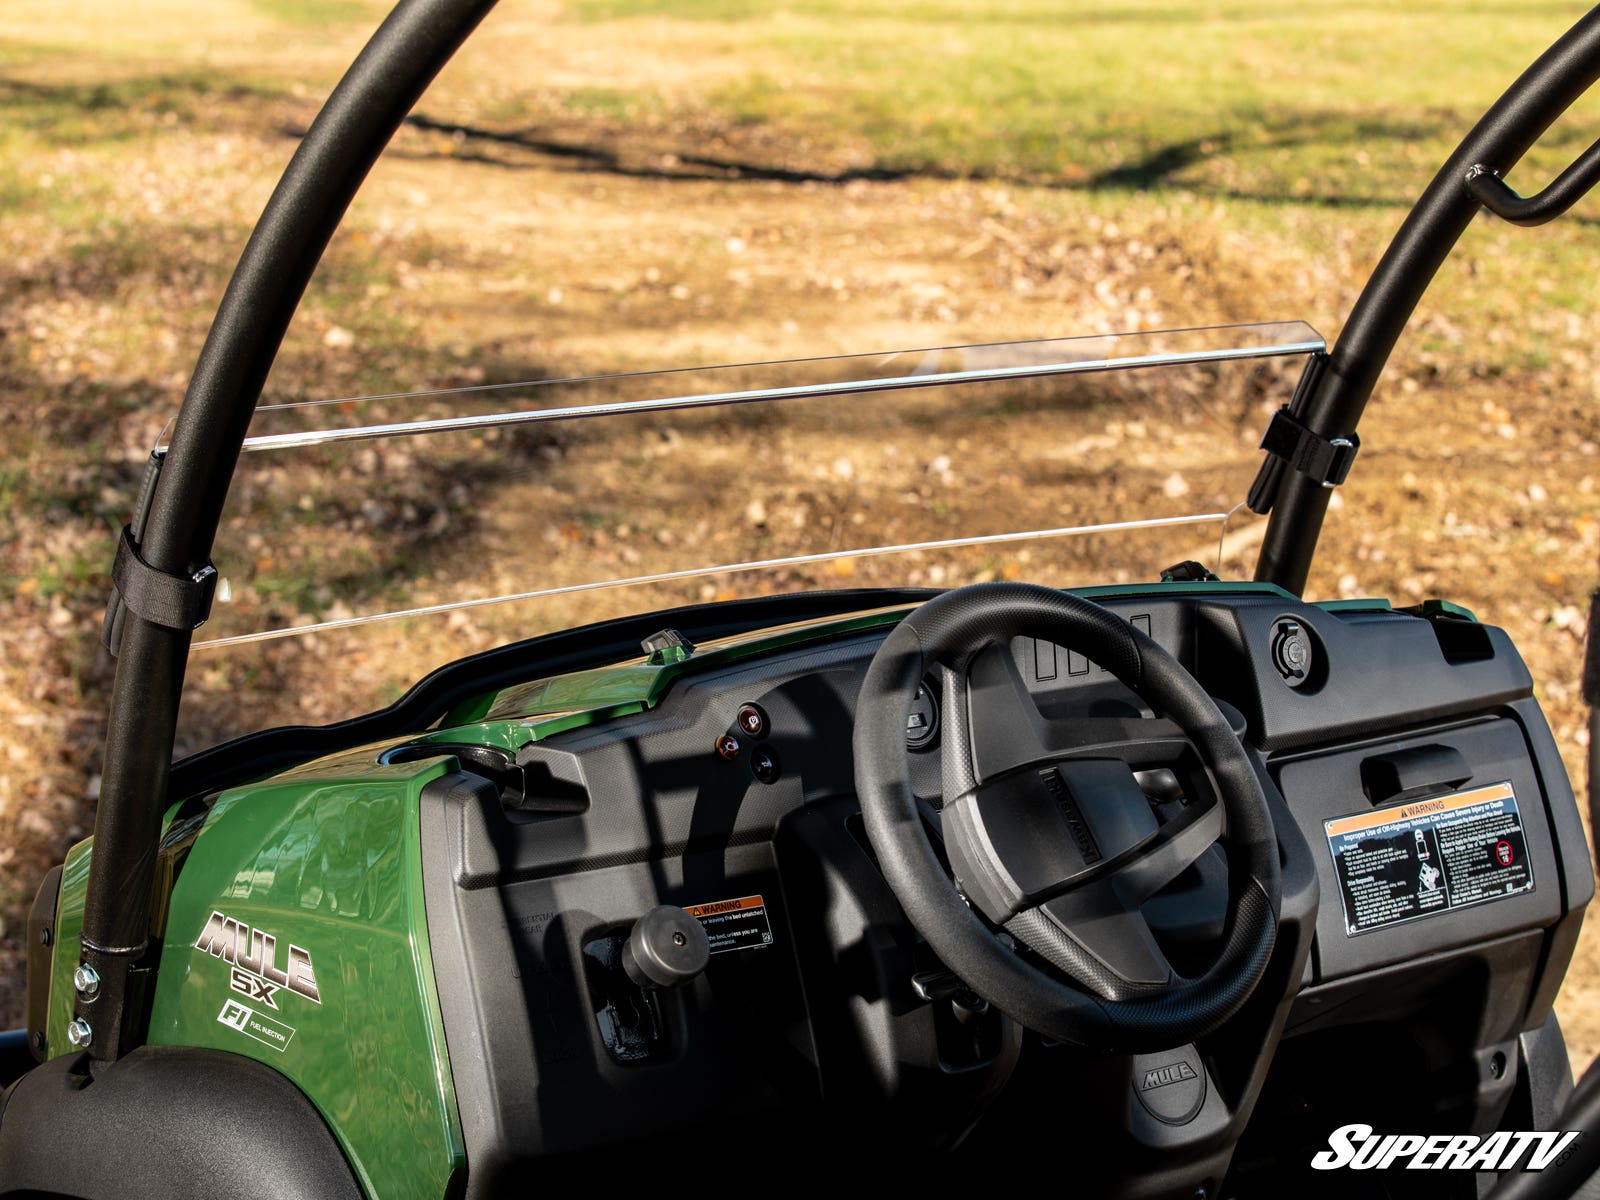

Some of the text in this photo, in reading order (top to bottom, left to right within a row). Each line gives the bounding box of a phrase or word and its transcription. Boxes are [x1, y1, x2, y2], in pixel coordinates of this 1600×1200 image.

[1407, 800, 1444, 816] WARNING
[1343, 830, 1366, 842] Improper
[1365, 828, 1376, 836] Use
[1381, 820, 1410, 834] Off-Highway
[1410, 816, 1429, 826] Vehicles
[1440, 811, 1455, 819] Cause
[1454, 807, 1471, 816] Severe
[1470, 804, 1484, 814] Injury
[1489, 800, 1504, 808] Death
[701, 900, 742, 914] WARNING
[732, 912, 741, 920] bed
[742, 910, 764, 918] unlatched
[195, 911, 321, 1004] MULE
[230, 967, 280, 1011] SX
[221, 1003, 249, 1029] FI
[250, 1020, 286, 1042] FUEL INJECTION
[1142, 1065, 1193, 1089] MULE
